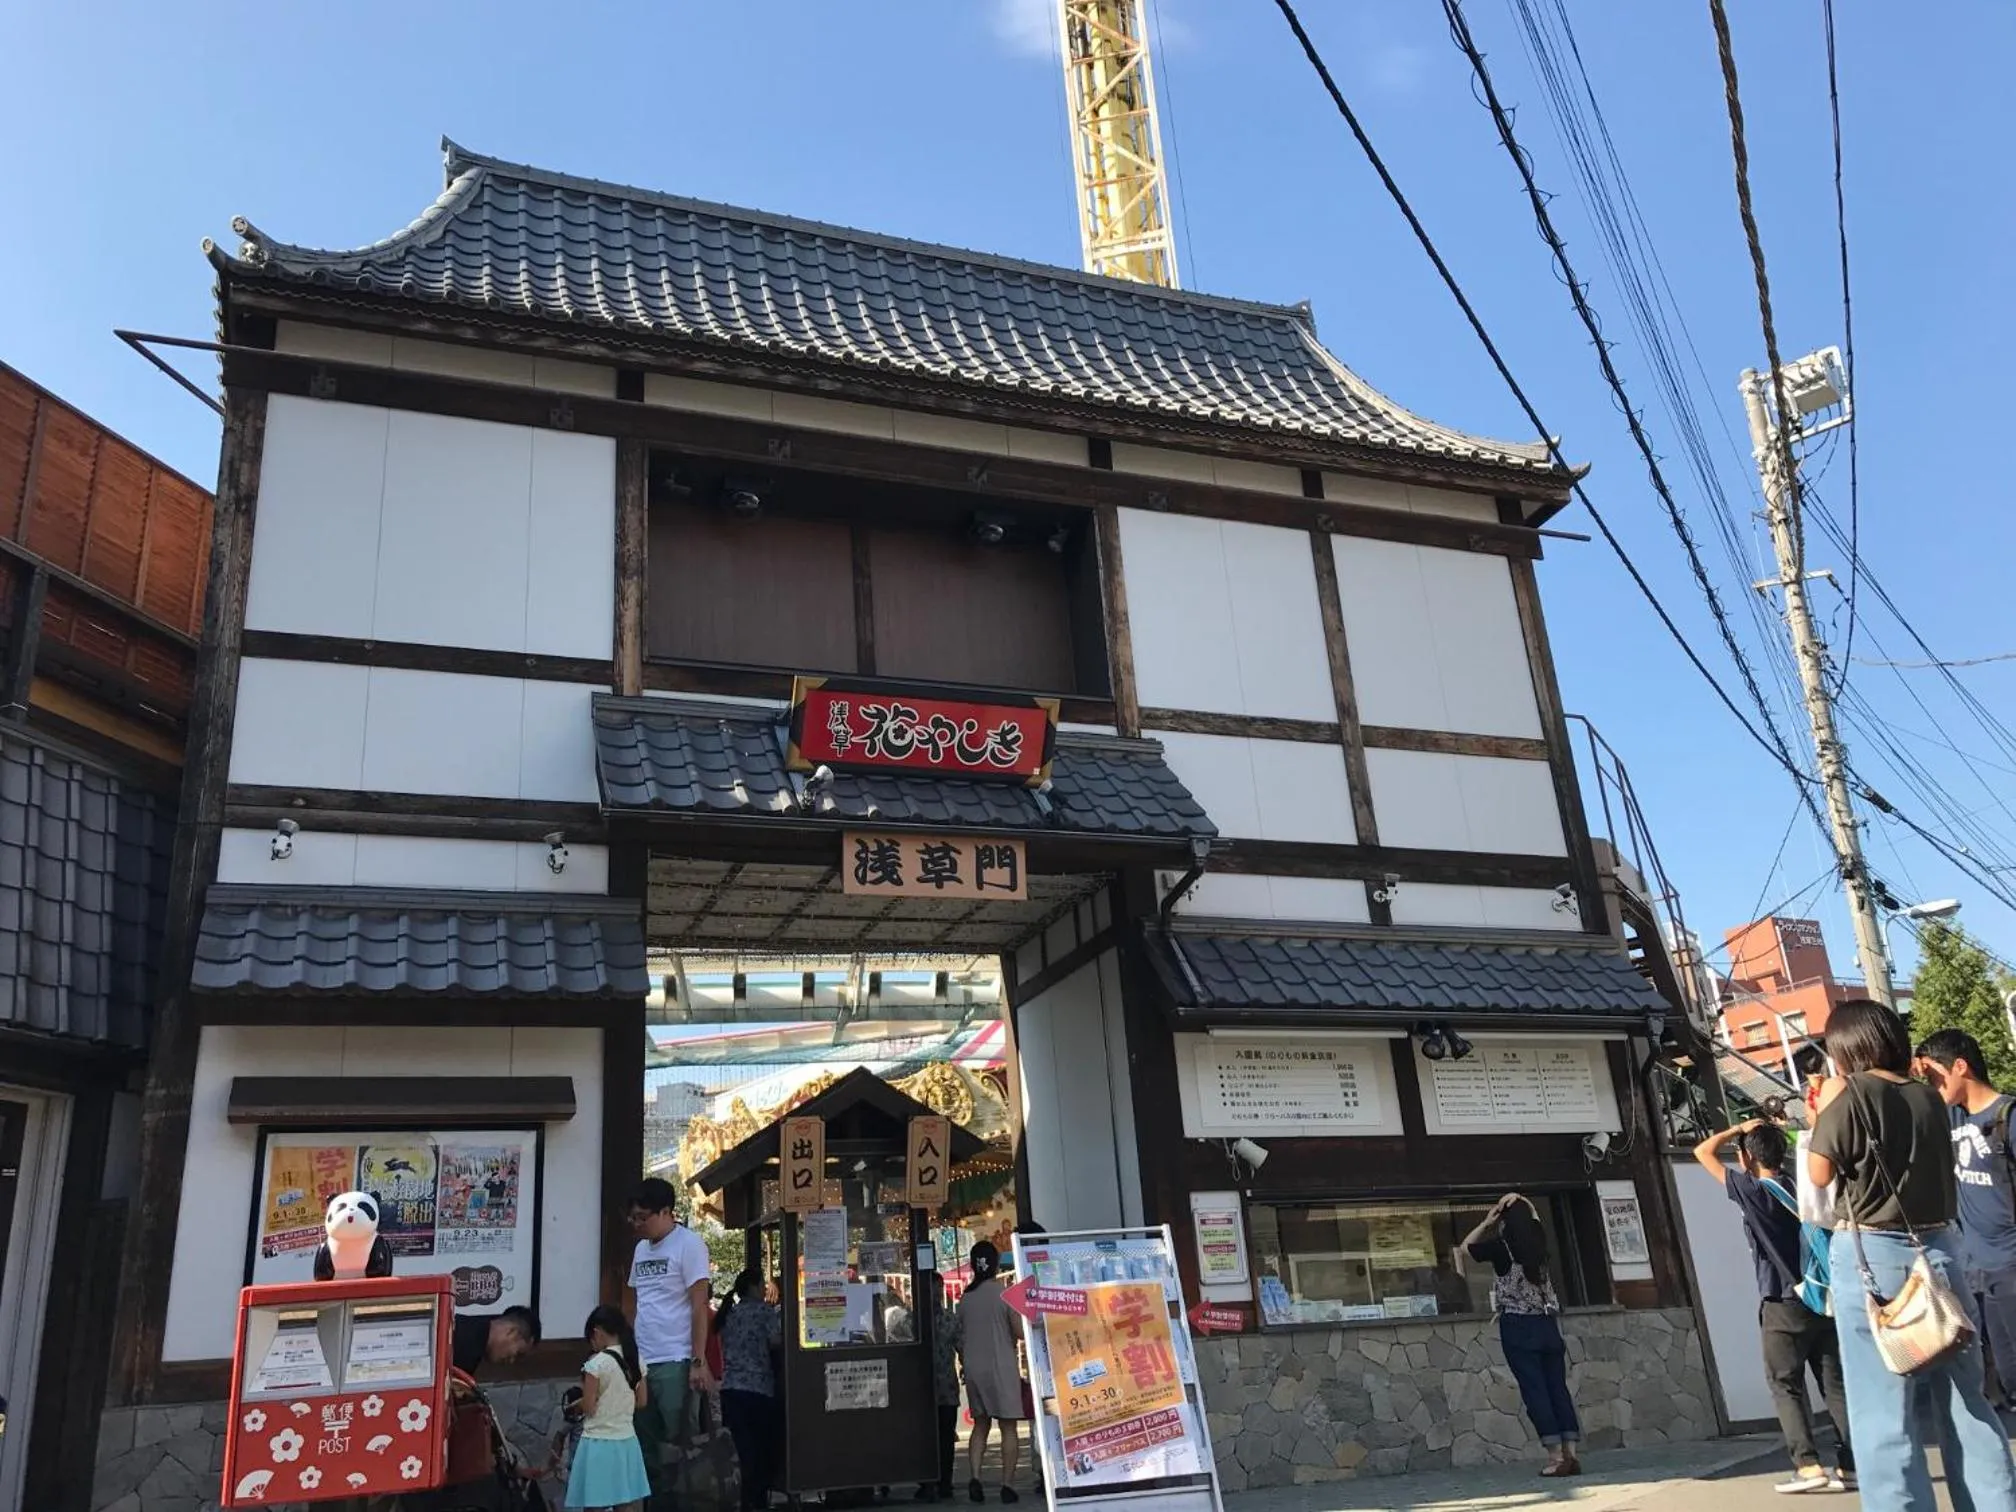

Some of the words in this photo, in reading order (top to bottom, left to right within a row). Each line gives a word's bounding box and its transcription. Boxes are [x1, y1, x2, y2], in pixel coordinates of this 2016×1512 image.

[827, 700, 852, 757] 浅草
[852, 702, 1023, 768] 花やしき
[853, 838, 1018, 893] 浅草門
[792, 1138, 814, 1190] 出口
[918, 1136, 940, 1187] 入口
[321, 1402, 354, 1421] 郵便
[318, 1437, 351, 1455] POST
